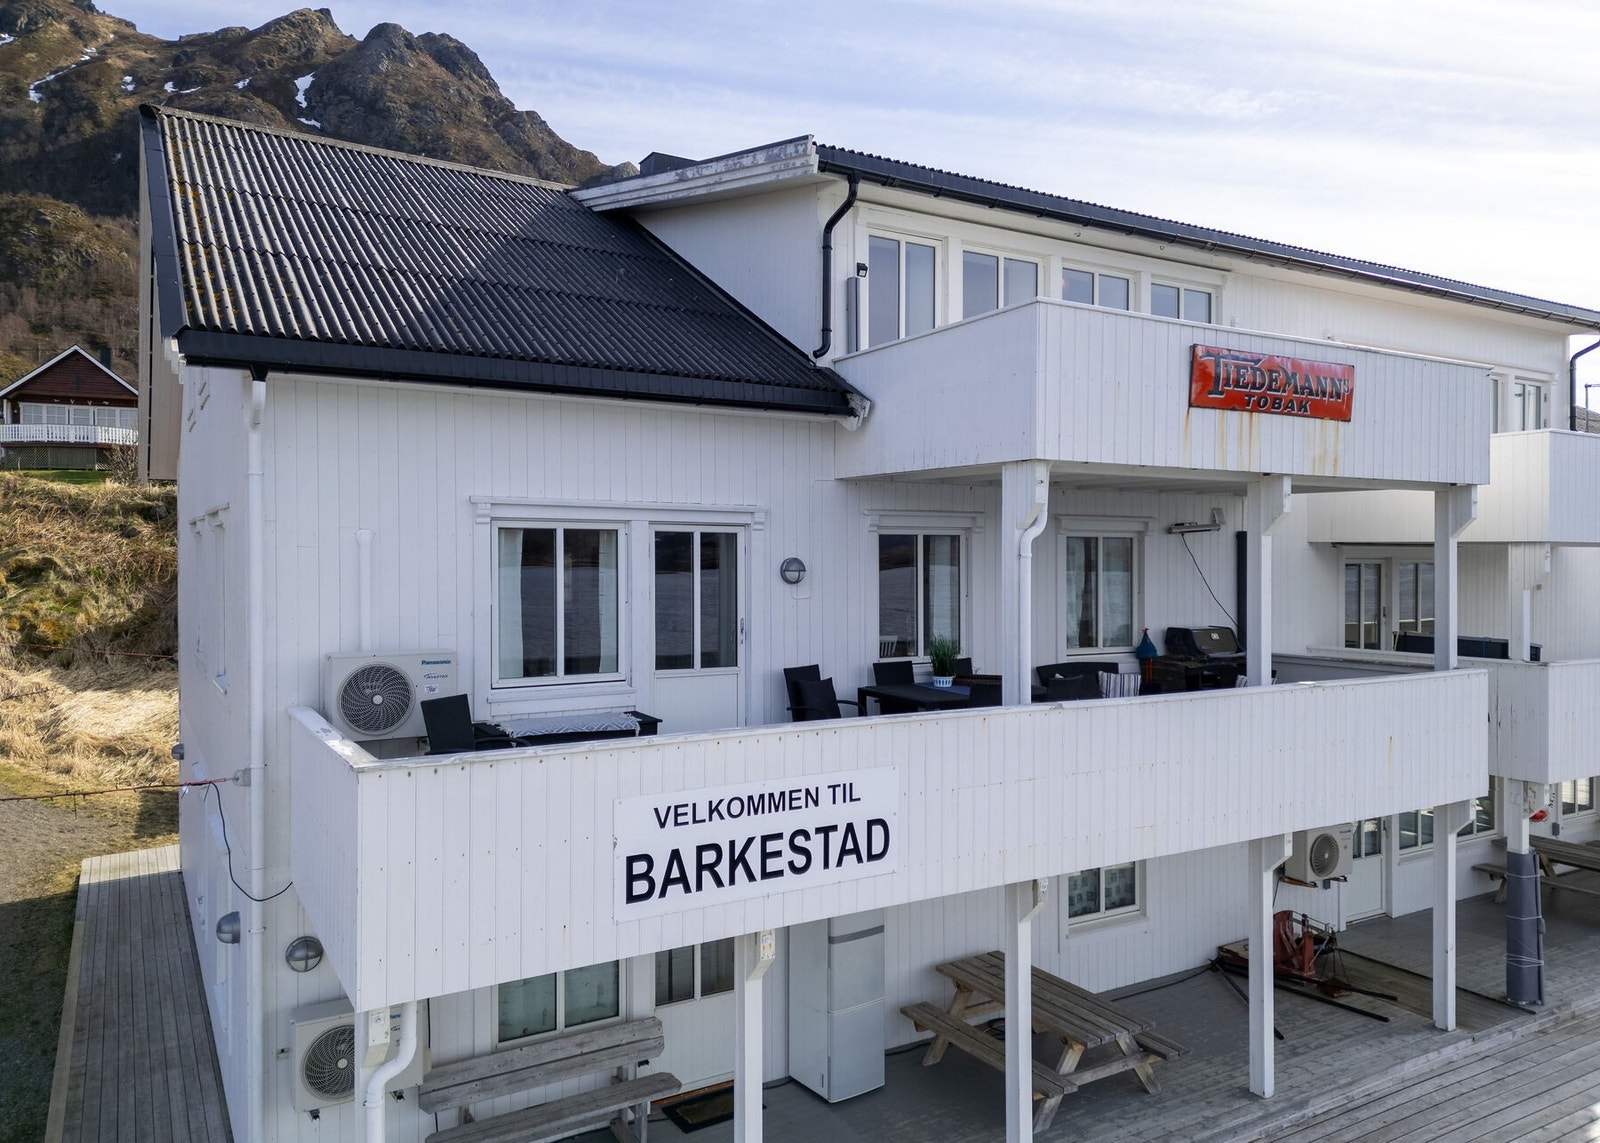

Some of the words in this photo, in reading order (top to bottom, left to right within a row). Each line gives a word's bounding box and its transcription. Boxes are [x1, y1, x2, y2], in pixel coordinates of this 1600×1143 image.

[1244, 394, 1311, 414] TOBAK
[653, 786, 820, 829] VELKOMMEN
[827, 782, 861, 805] TIL
[625, 818, 890, 904] BARKESTAD
